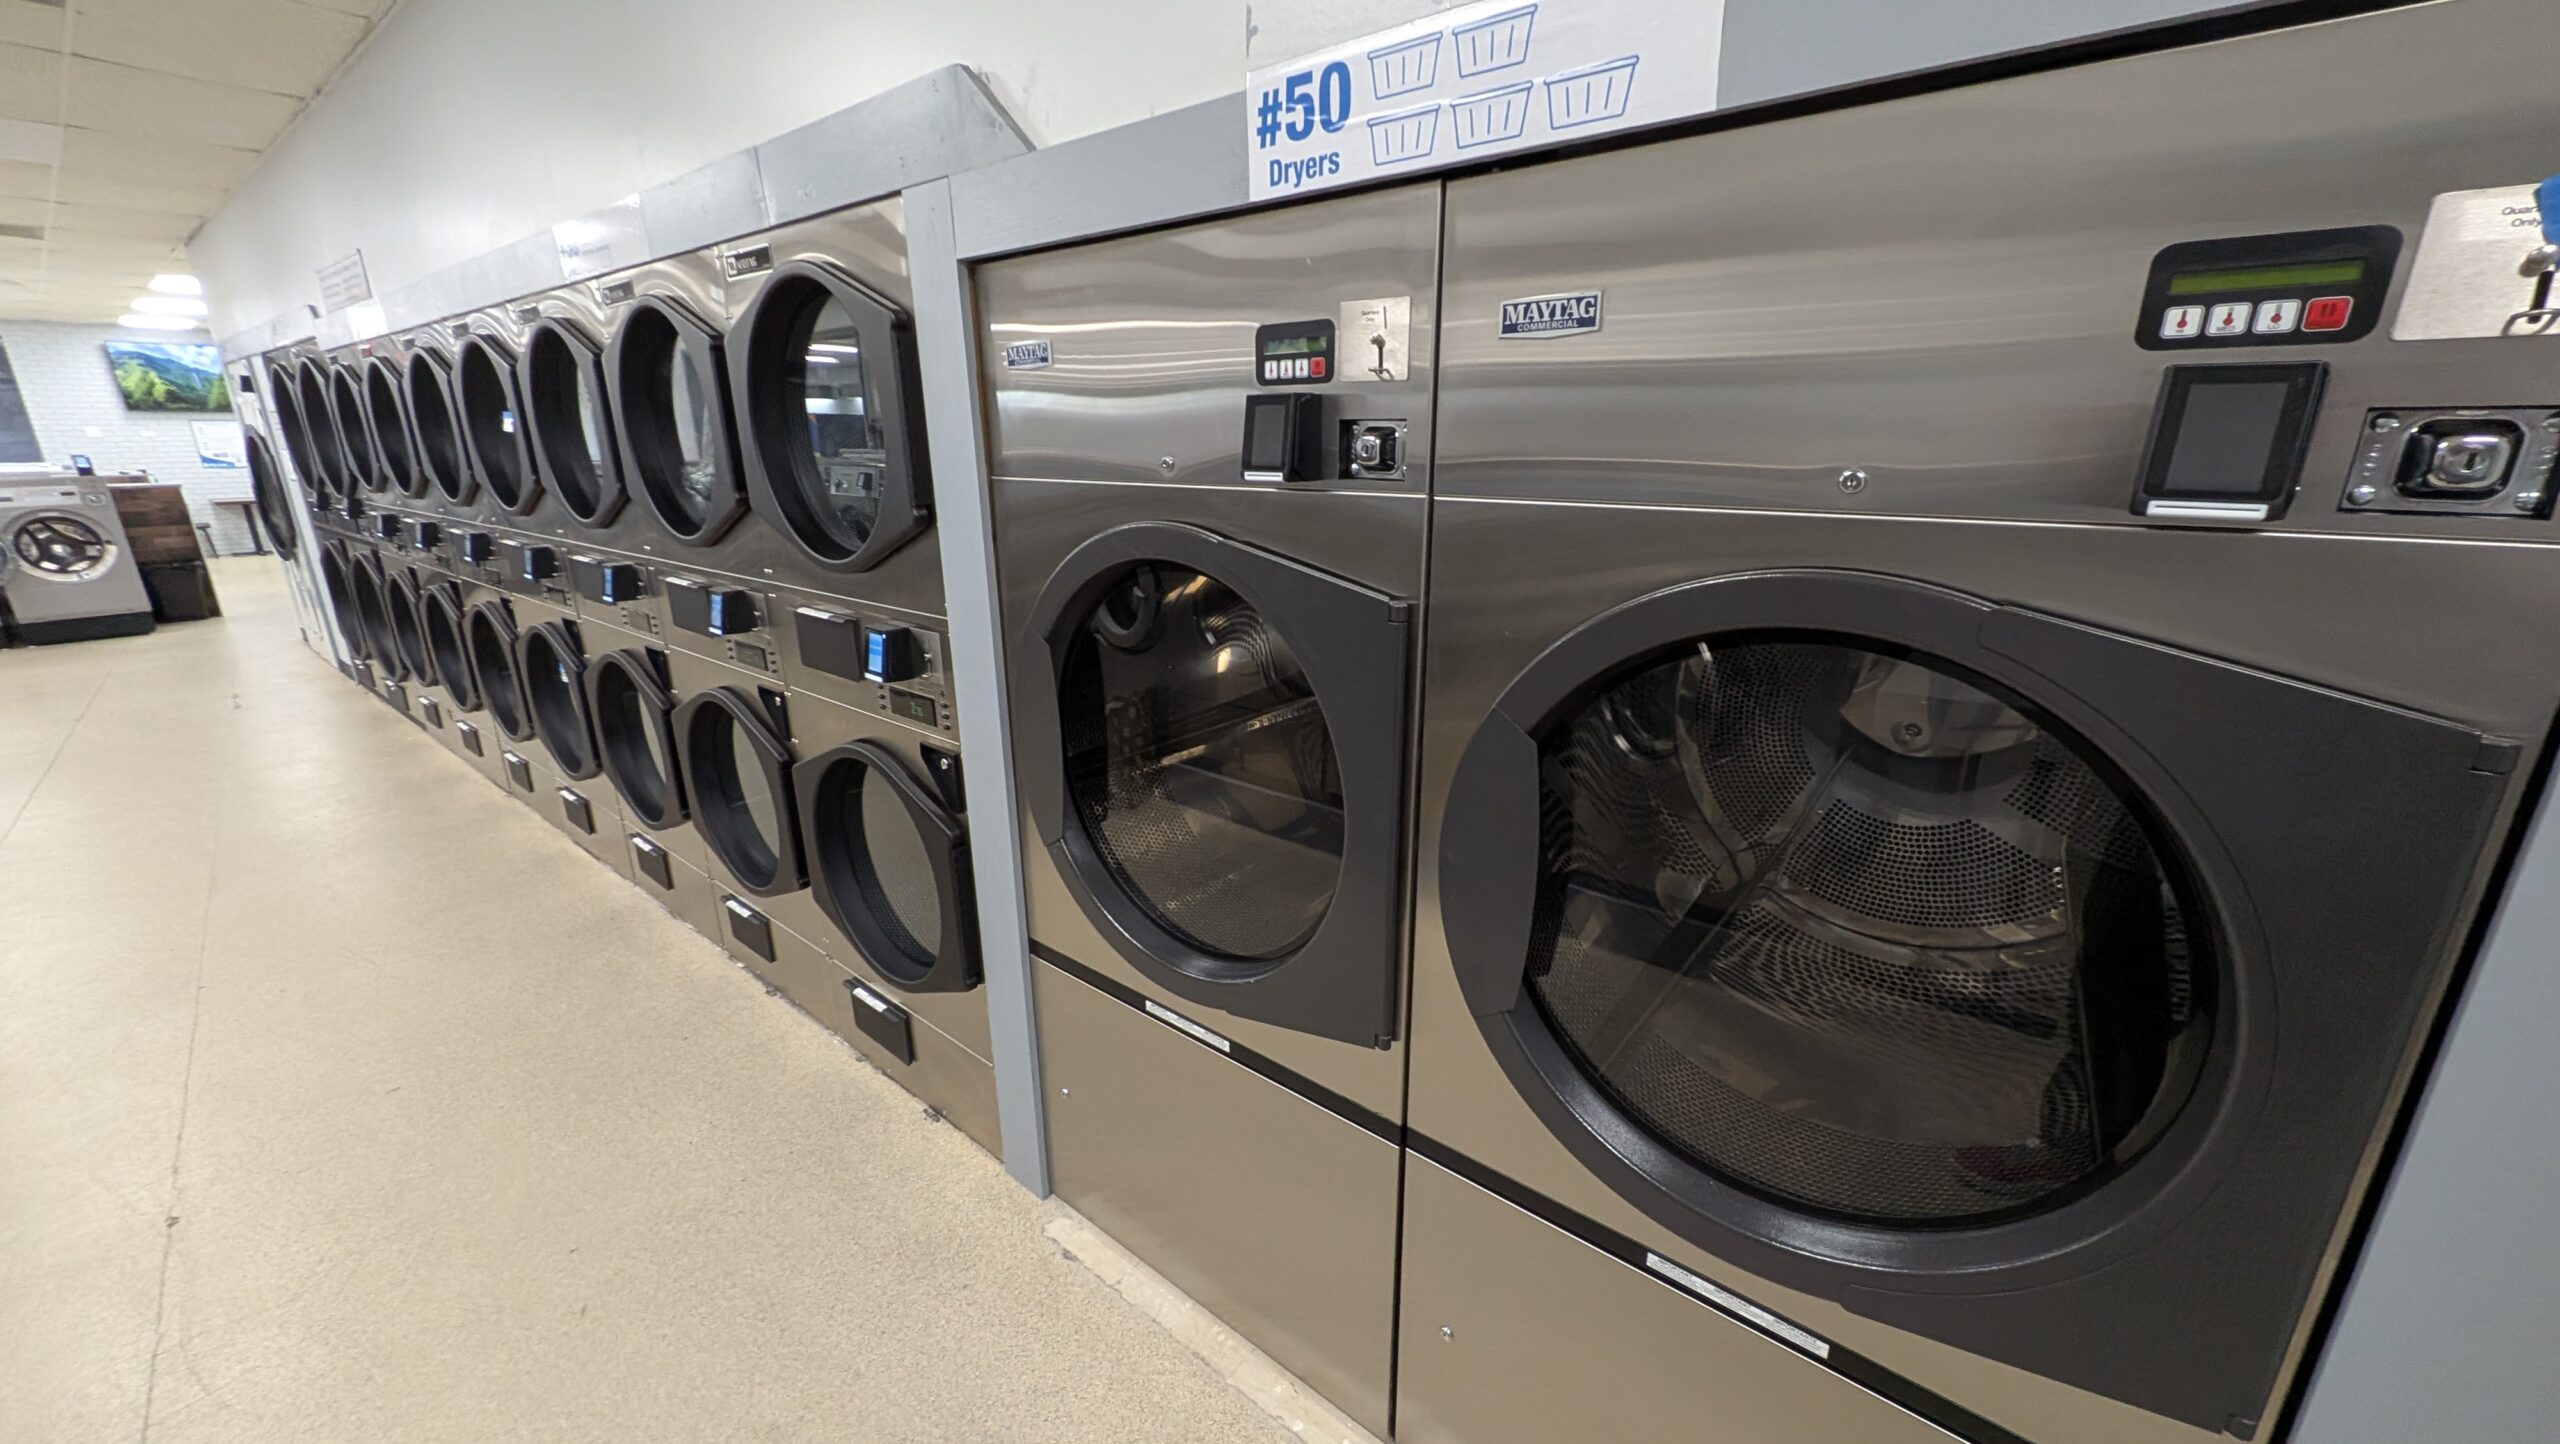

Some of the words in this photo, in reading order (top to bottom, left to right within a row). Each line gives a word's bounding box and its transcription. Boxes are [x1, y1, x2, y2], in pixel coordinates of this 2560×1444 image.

[1257, 61, 1351, 149] #50
[1269, 152, 1340, 188] Dryers
[1504, 297, 1596, 325] MAYTAG
[1517, 320, 1578, 332] COMMERCIAL
[1008, 343, 1048, 361] MAYTAG
